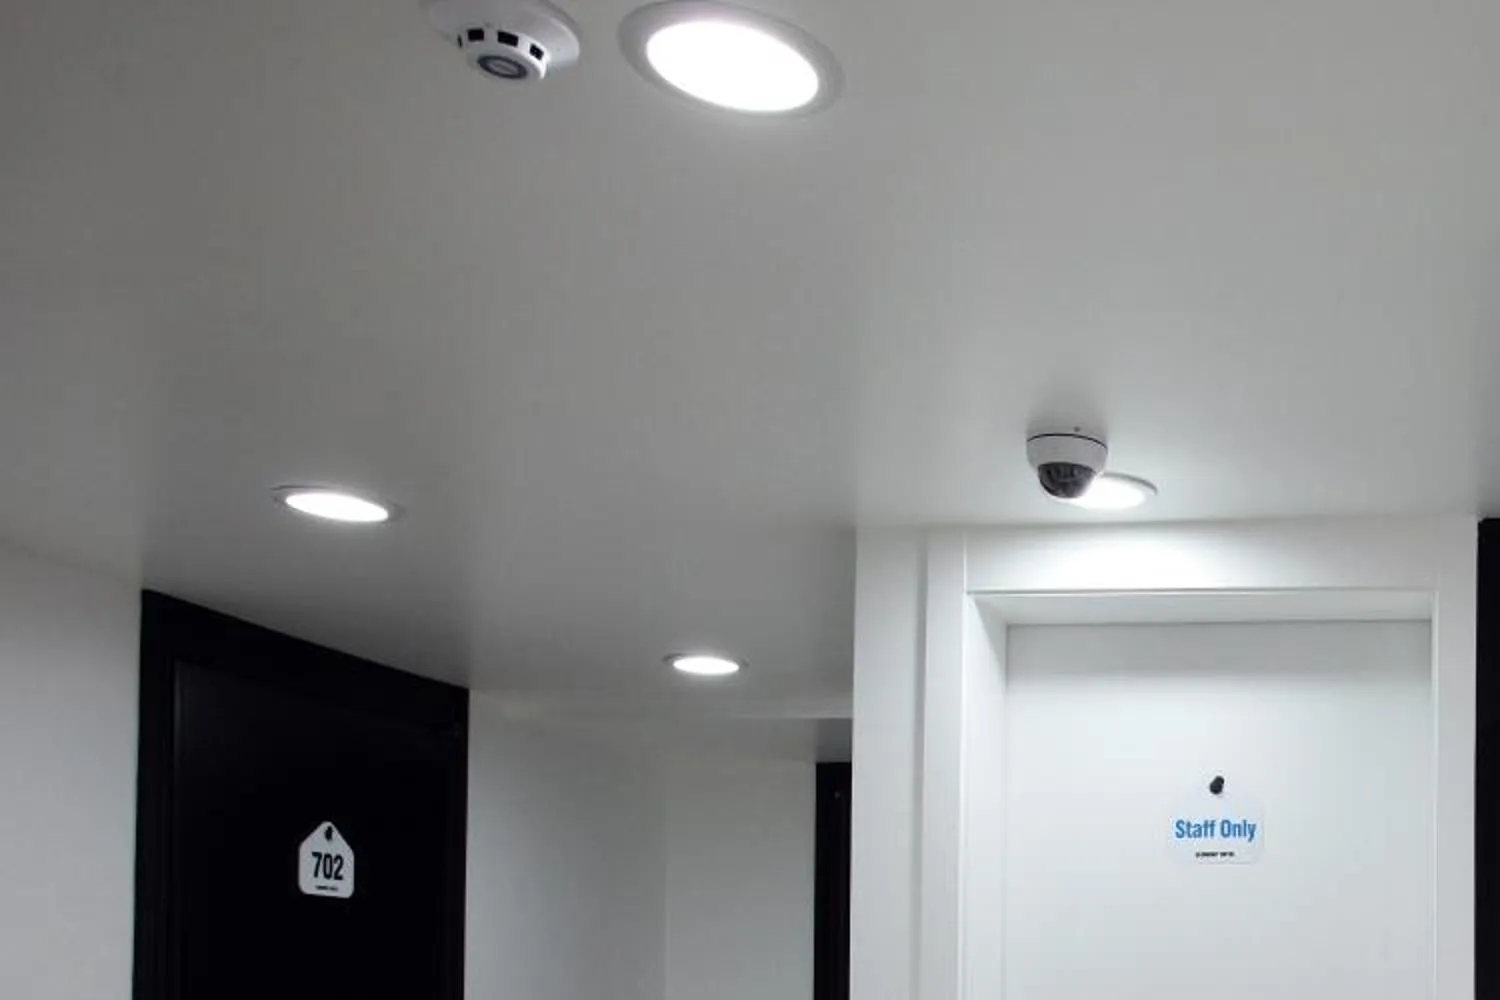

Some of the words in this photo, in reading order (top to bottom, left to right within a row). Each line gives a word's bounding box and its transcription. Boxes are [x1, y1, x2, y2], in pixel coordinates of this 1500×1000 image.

[1175, 819, 1217, 839] Staff
[1220, 819, 1257, 843] Only
[311, 851, 345, 881] 702
